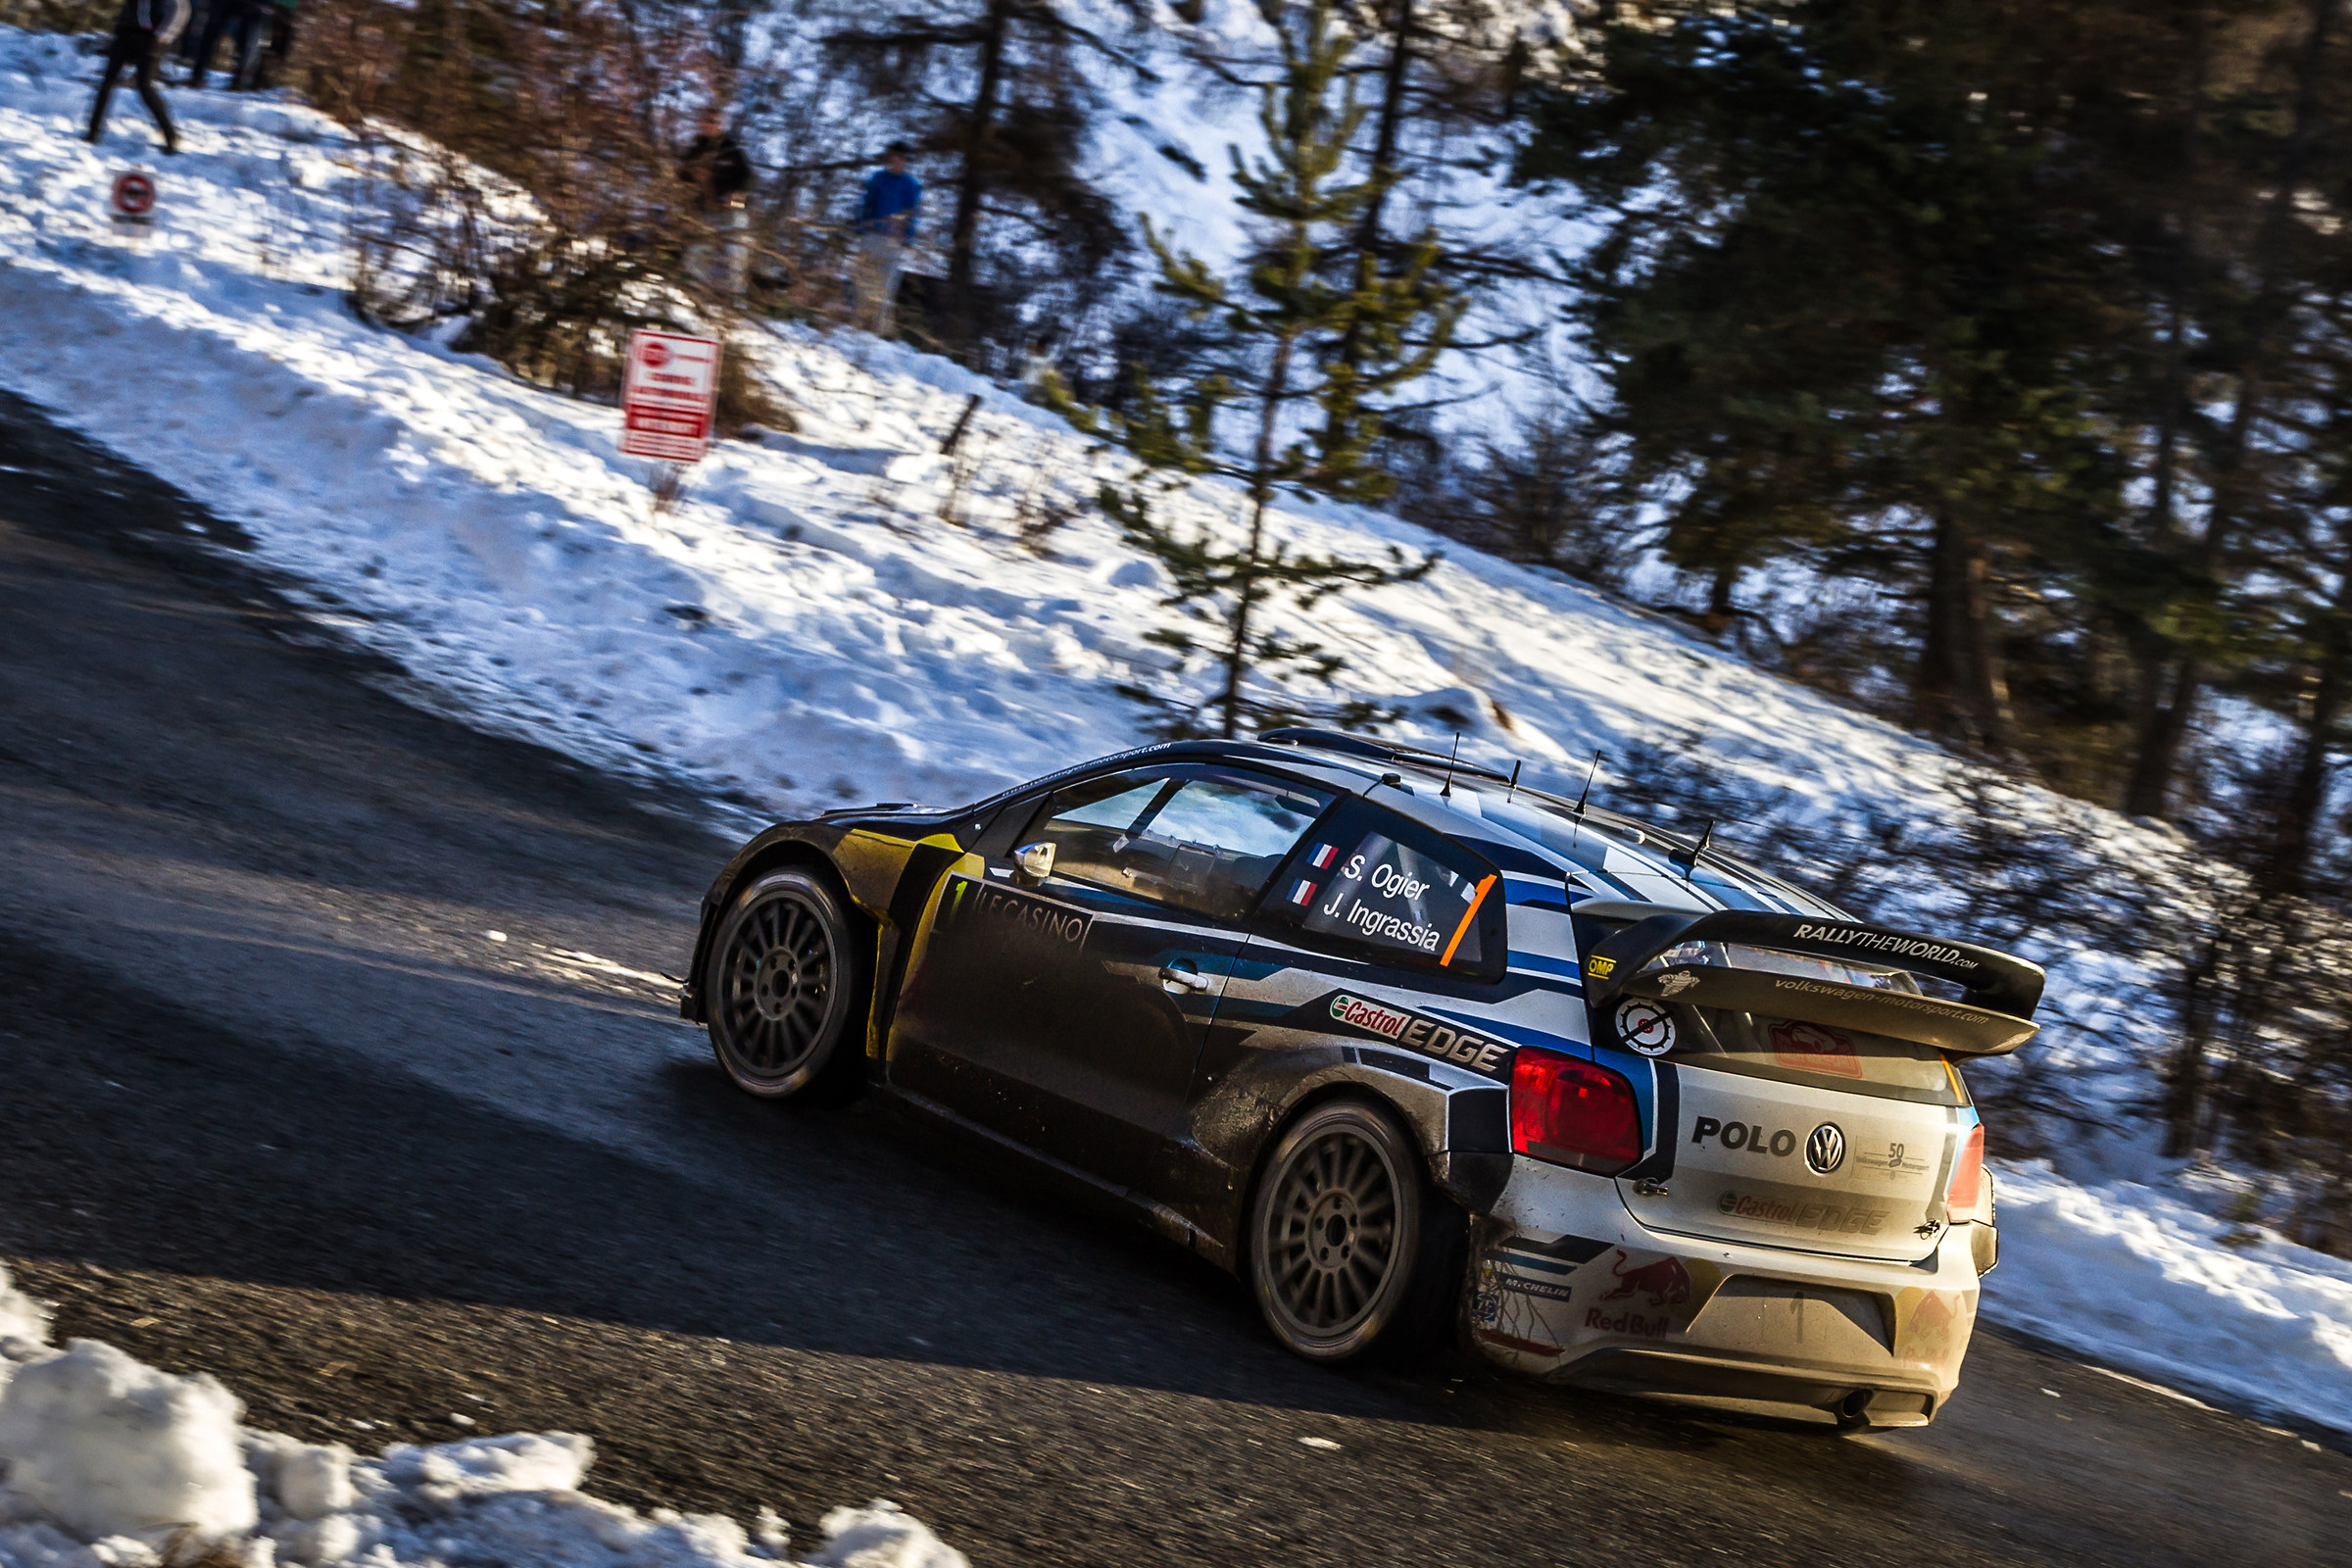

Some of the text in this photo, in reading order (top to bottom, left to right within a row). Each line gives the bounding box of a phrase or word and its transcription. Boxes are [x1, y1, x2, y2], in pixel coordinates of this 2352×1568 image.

[1345, 855, 1431, 902] S. Ogier
[1323, 893, 1441, 952] J. Ingrassia
[1440, 873, 1497, 967] 1
[1589, 958, 1615, 976] OMP
[1775, 979, 1989, 1025] volkswagen-motorsport.com
[1345, 1001, 1510, 1072] Castrol EDGE
[1691, 1115, 1796, 1157] POLO
[1887, 1142, 1905, 1158] 50
[1735, 1195, 1890, 1236] Castrol EDGE
[1585, 1306, 1670, 1339] Red Bull
